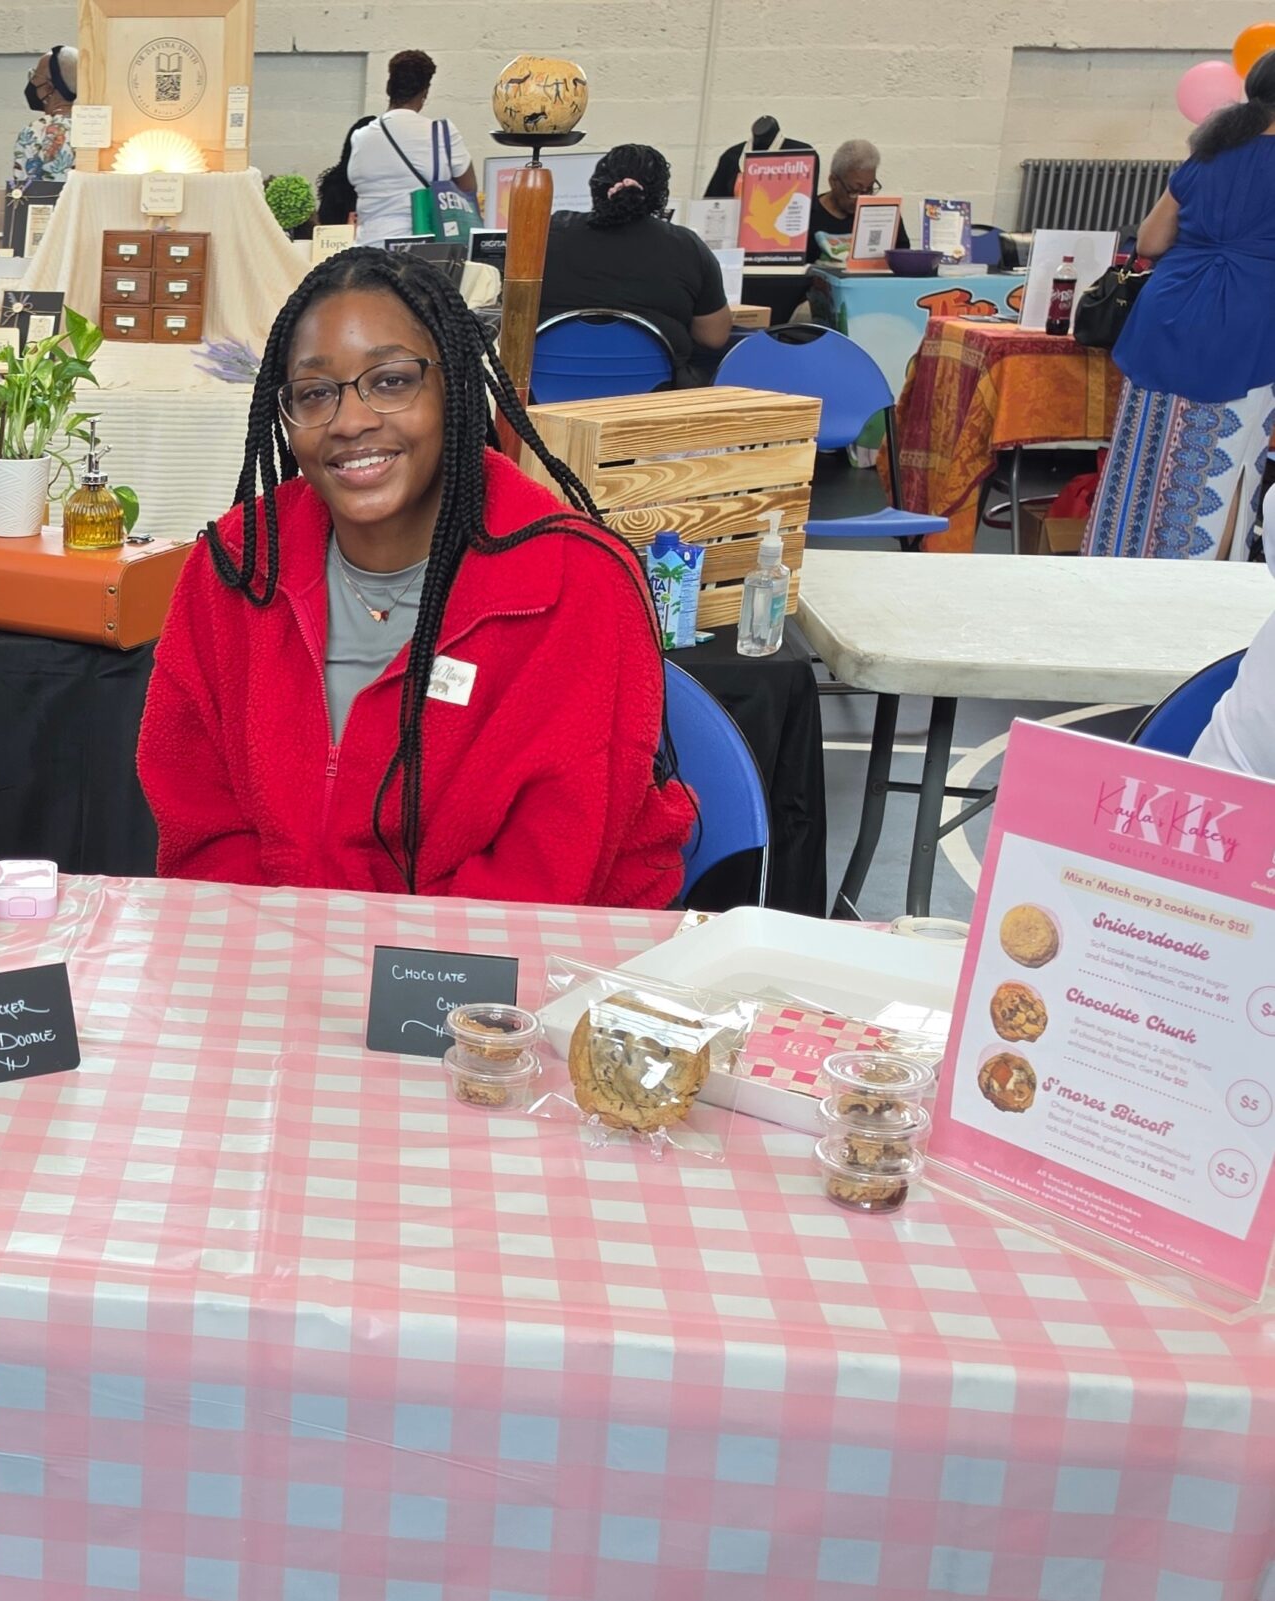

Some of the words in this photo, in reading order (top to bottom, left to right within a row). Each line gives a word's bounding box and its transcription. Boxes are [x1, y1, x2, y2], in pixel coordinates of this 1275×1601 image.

[179, 43, 200, 65] SMITH
[747, 160, 810, 177] Gracefully
[480, 240, 506, 248] DIGITA
[1109, 775, 1244, 864] KK
[1166, 801, 1240, 863] Kakery
[1108, 842, 1157, 862] QUALITY
[1161, 857, 1220, 880] DESSERTS
[1064, 871, 1084, 884] Mix
[1085, 878, 1096, 887] n'
[1096, 880, 1131, 899] Match
[1133, 892, 1152, 907] any
[1155, 898, 1162, 908] 3
[1164, 903, 1206, 922] cookies
[1208, 914, 1225, 926] for
[1228, 919, 1251, 934] $12!
[1092, 911, 1211, 961] Snickerdoodle
[1085, 951, 1101, 962] and
[1101, 955, 1125, 970] baked
[1126, 964, 1134, 973] to
[1134, 967, 1175, 987] perfection.
[1177, 981, 1193, 992] Get
[1194, 986, 1201, 994] 3
[1202, 988, 1214, 999] for
[1090, 938, 1106, 949] Soft
[1107, 945, 1135, 960] cookies
[1136, 955, 1158, 967] rolled
[1159, 961, 1166, 970] in
[1167, 965, 1205, 982] cinnamon
[1206, 978, 1230, 990] sugar
[1066, 987, 1141, 1024] Chocolate
[1145, 1015, 1197, 1044] Chunk
[783, 1040, 826, 1060] KK
[1074, 1016, 1096, 1029] Brown
[1097, 1025, 1116, 1037] sugar
[1136, 1039, 1152, 1050] with
[1153, 1044, 1159, 1053] 2
[1192, 1059, 1213, 1072] types
[1154, 1069, 1160, 1078] 3
[1160, 1071, 1173, 1082] for
[1041, 1076, 1107, 1113] S'mores
[1110, 1103, 1175, 1137] Biscoff
[1239, 1094, 1260, 1112] $5
[1037, 1168, 1046, 1178] All
[1139, 1160, 1146, 1169] 3
[1147, 1162, 1159, 1174] for
[1215, 1161, 1250, 1185] $5.5
[1016, 1179, 1040, 1195] bakery
[1076, 1205, 1097, 1220] under
[1098, 1214, 1133, 1235] Maryland
[1133, 1229, 1165, 1248] Cottage
